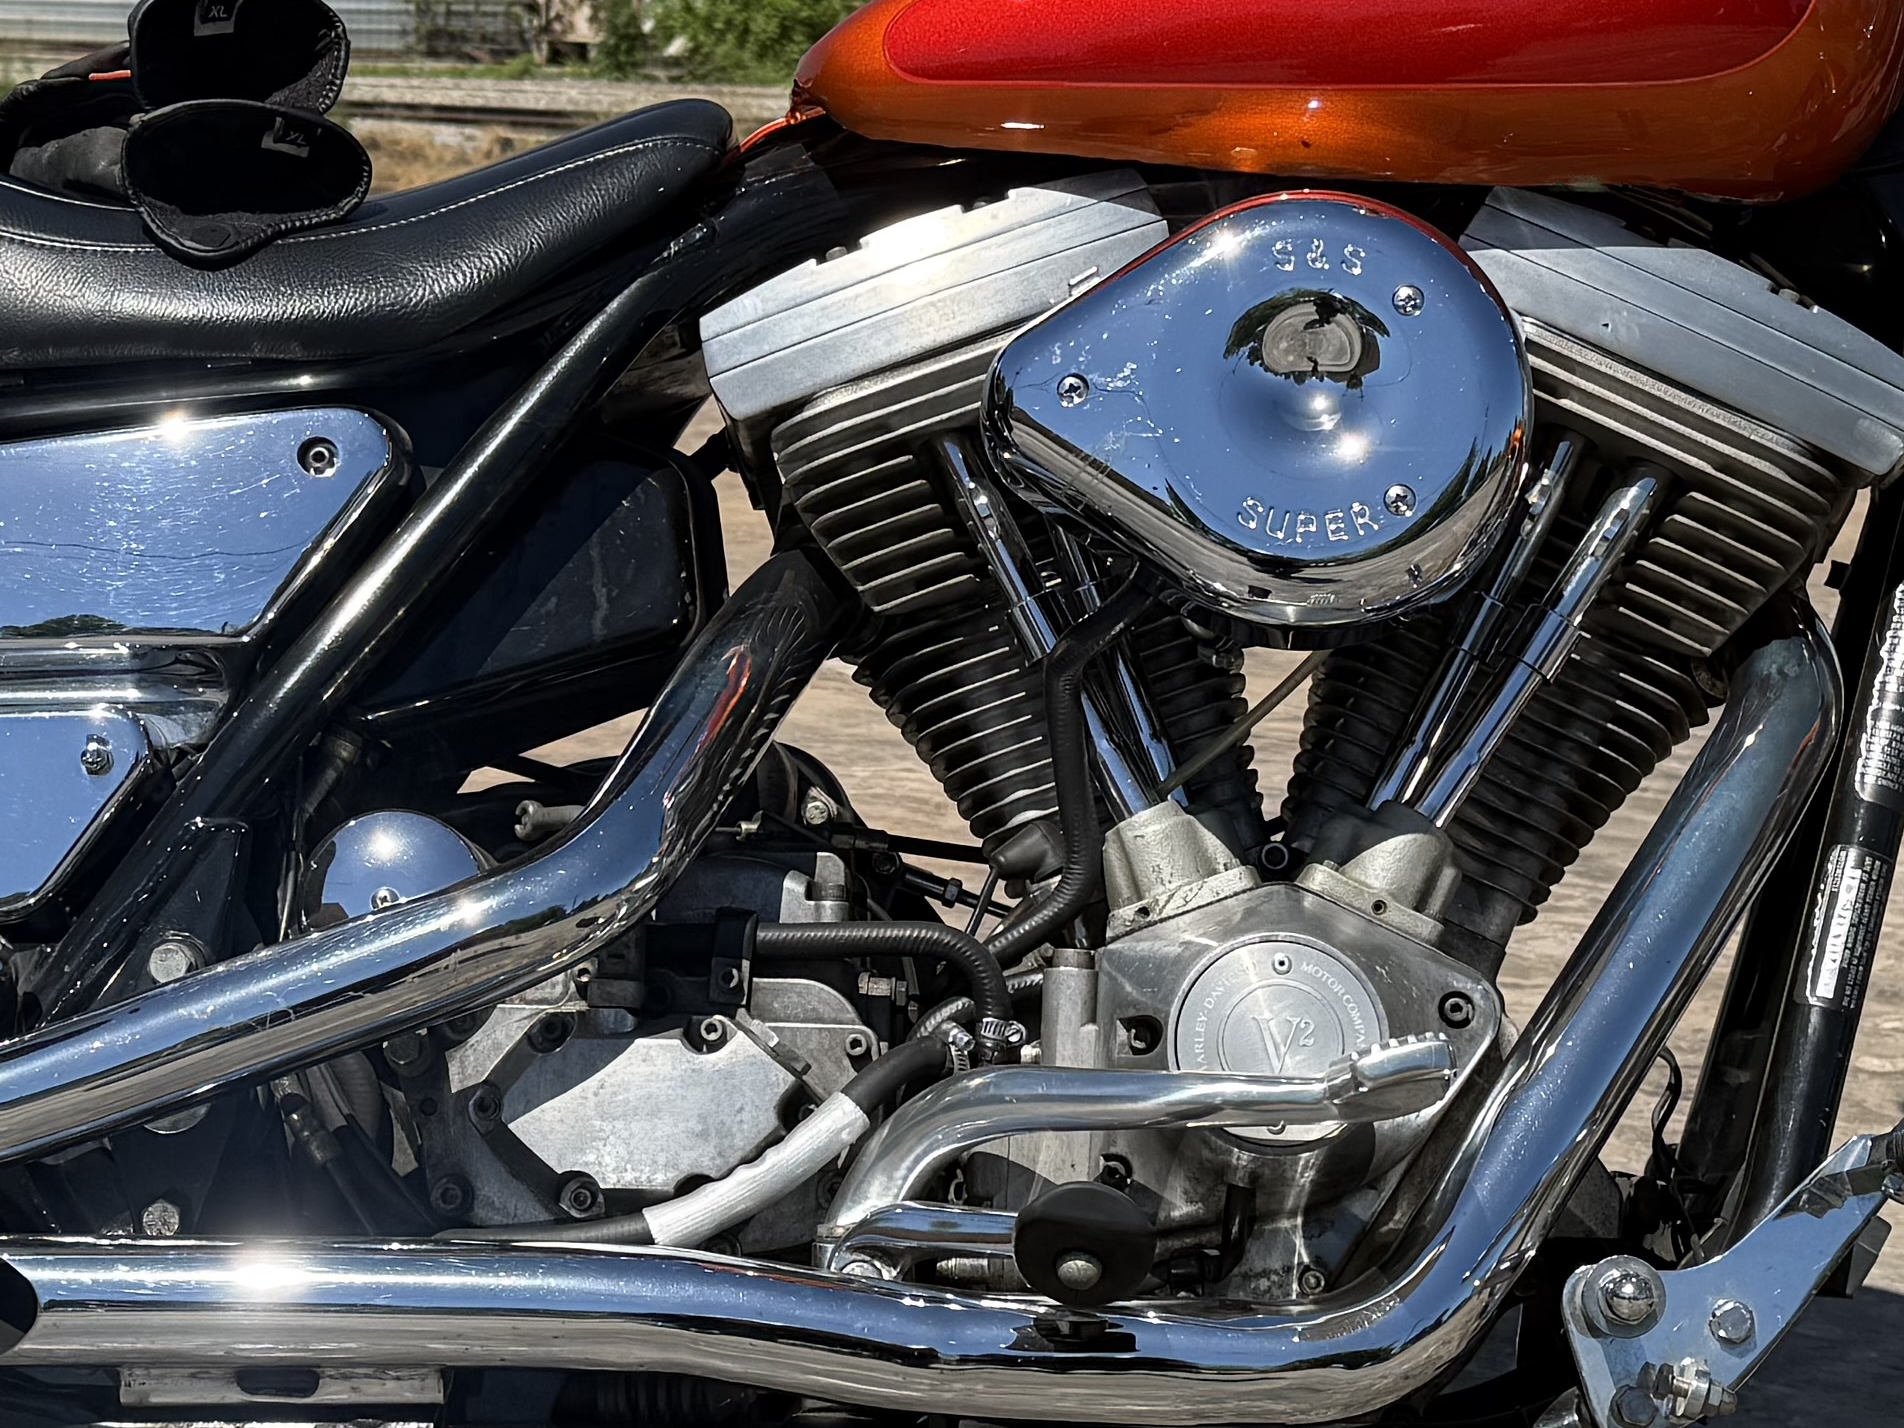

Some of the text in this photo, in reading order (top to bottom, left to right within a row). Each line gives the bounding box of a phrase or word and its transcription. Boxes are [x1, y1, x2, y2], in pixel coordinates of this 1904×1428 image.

[207, 4, 228, 19] XL
[1236, 496, 1381, 544] SUPER
[1299, 960, 1345, 996] MOTOR
